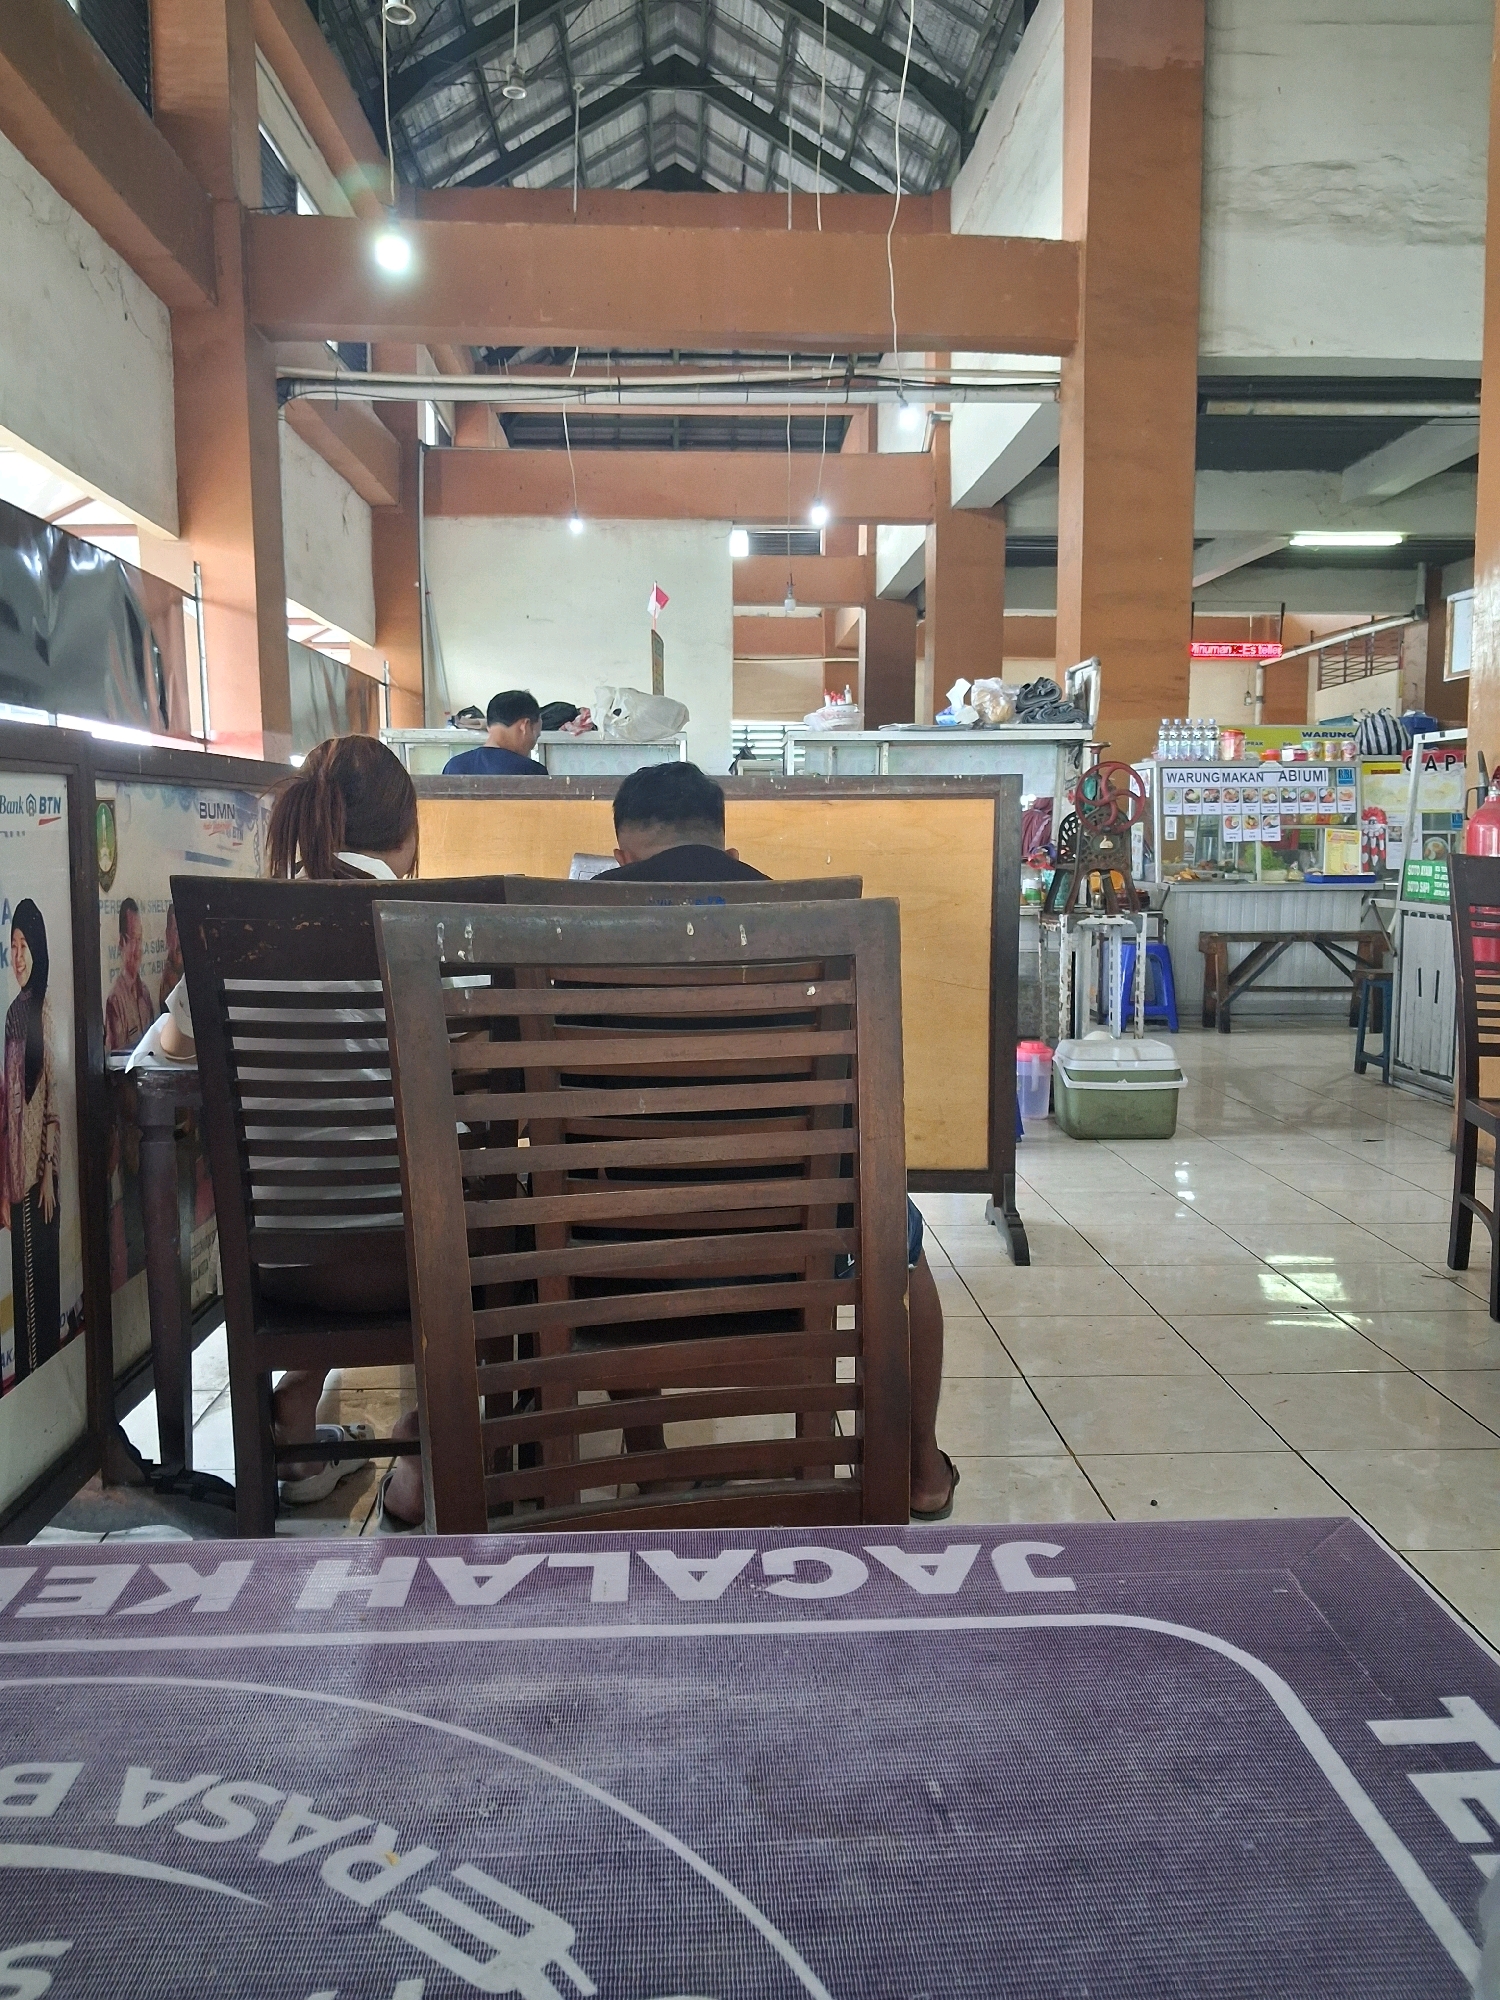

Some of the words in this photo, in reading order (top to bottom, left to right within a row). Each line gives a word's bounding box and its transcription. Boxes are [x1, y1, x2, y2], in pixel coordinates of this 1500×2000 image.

[1166, 772, 1220, 783] WARUNG
[1222, 771, 1264, 783] MAKAN
[0, 794, 24, 815] Bank
[39, 796, 61, 815] BTN
[199, 801, 236, 819] BUMN
[296, 1541, 1076, 1610] JAGALAH
[1366, 1696, 1500, 1879] TE
[115, 1766, 439, 1906] RASA
